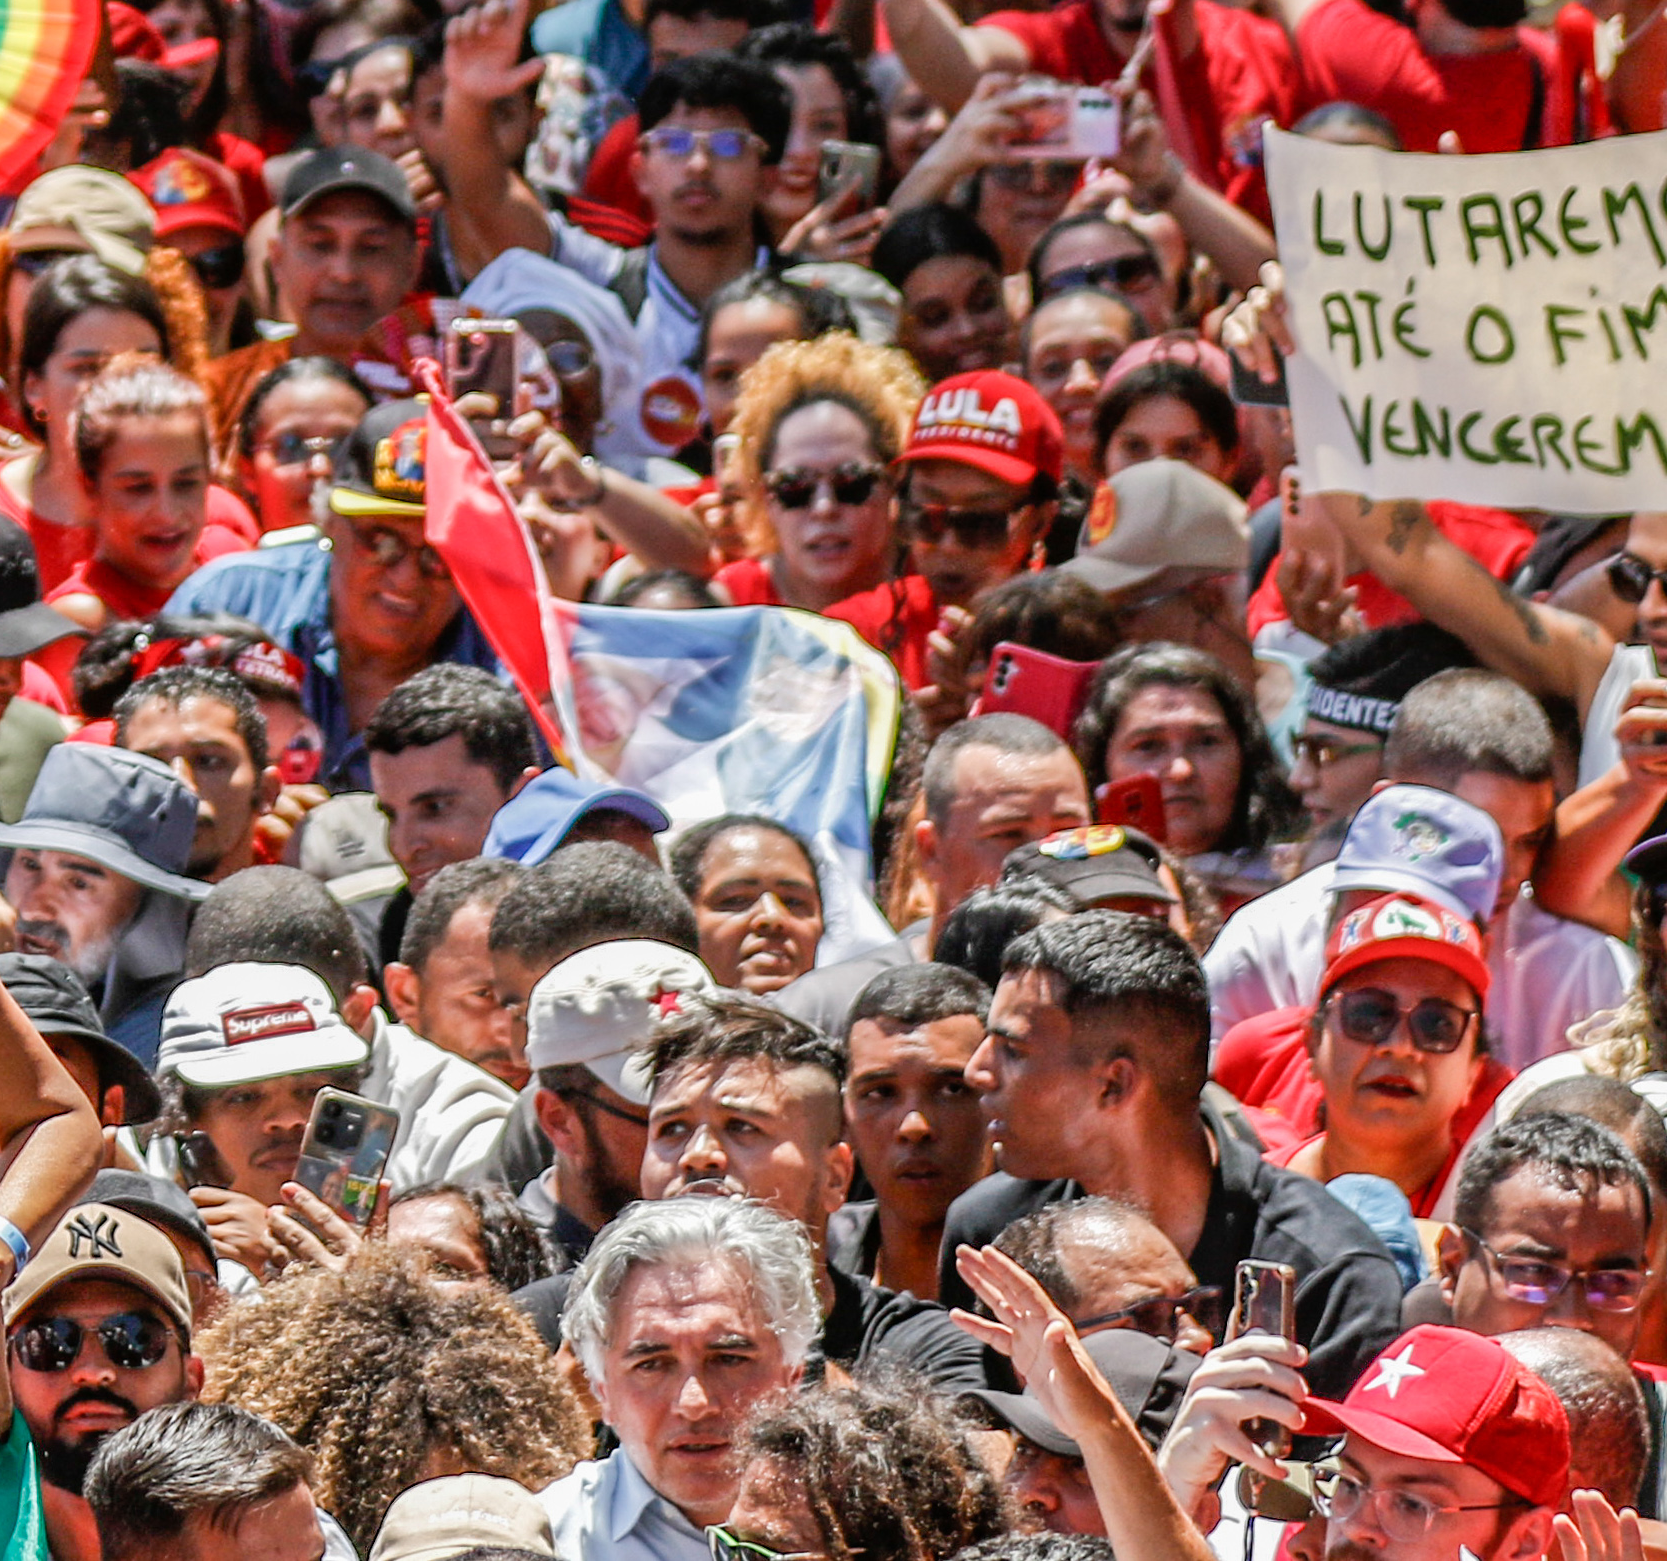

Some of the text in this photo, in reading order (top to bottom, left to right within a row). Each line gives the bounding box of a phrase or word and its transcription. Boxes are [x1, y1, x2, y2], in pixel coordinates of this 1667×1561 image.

[1313, 181, 1667, 269] LUTAREM
[1322, 275, 1432, 370] ATÉ
[1465, 303, 1515, 366] O
[917, 387, 1023, 436] LULA
[227, 1008, 310, 1036] Supreme
